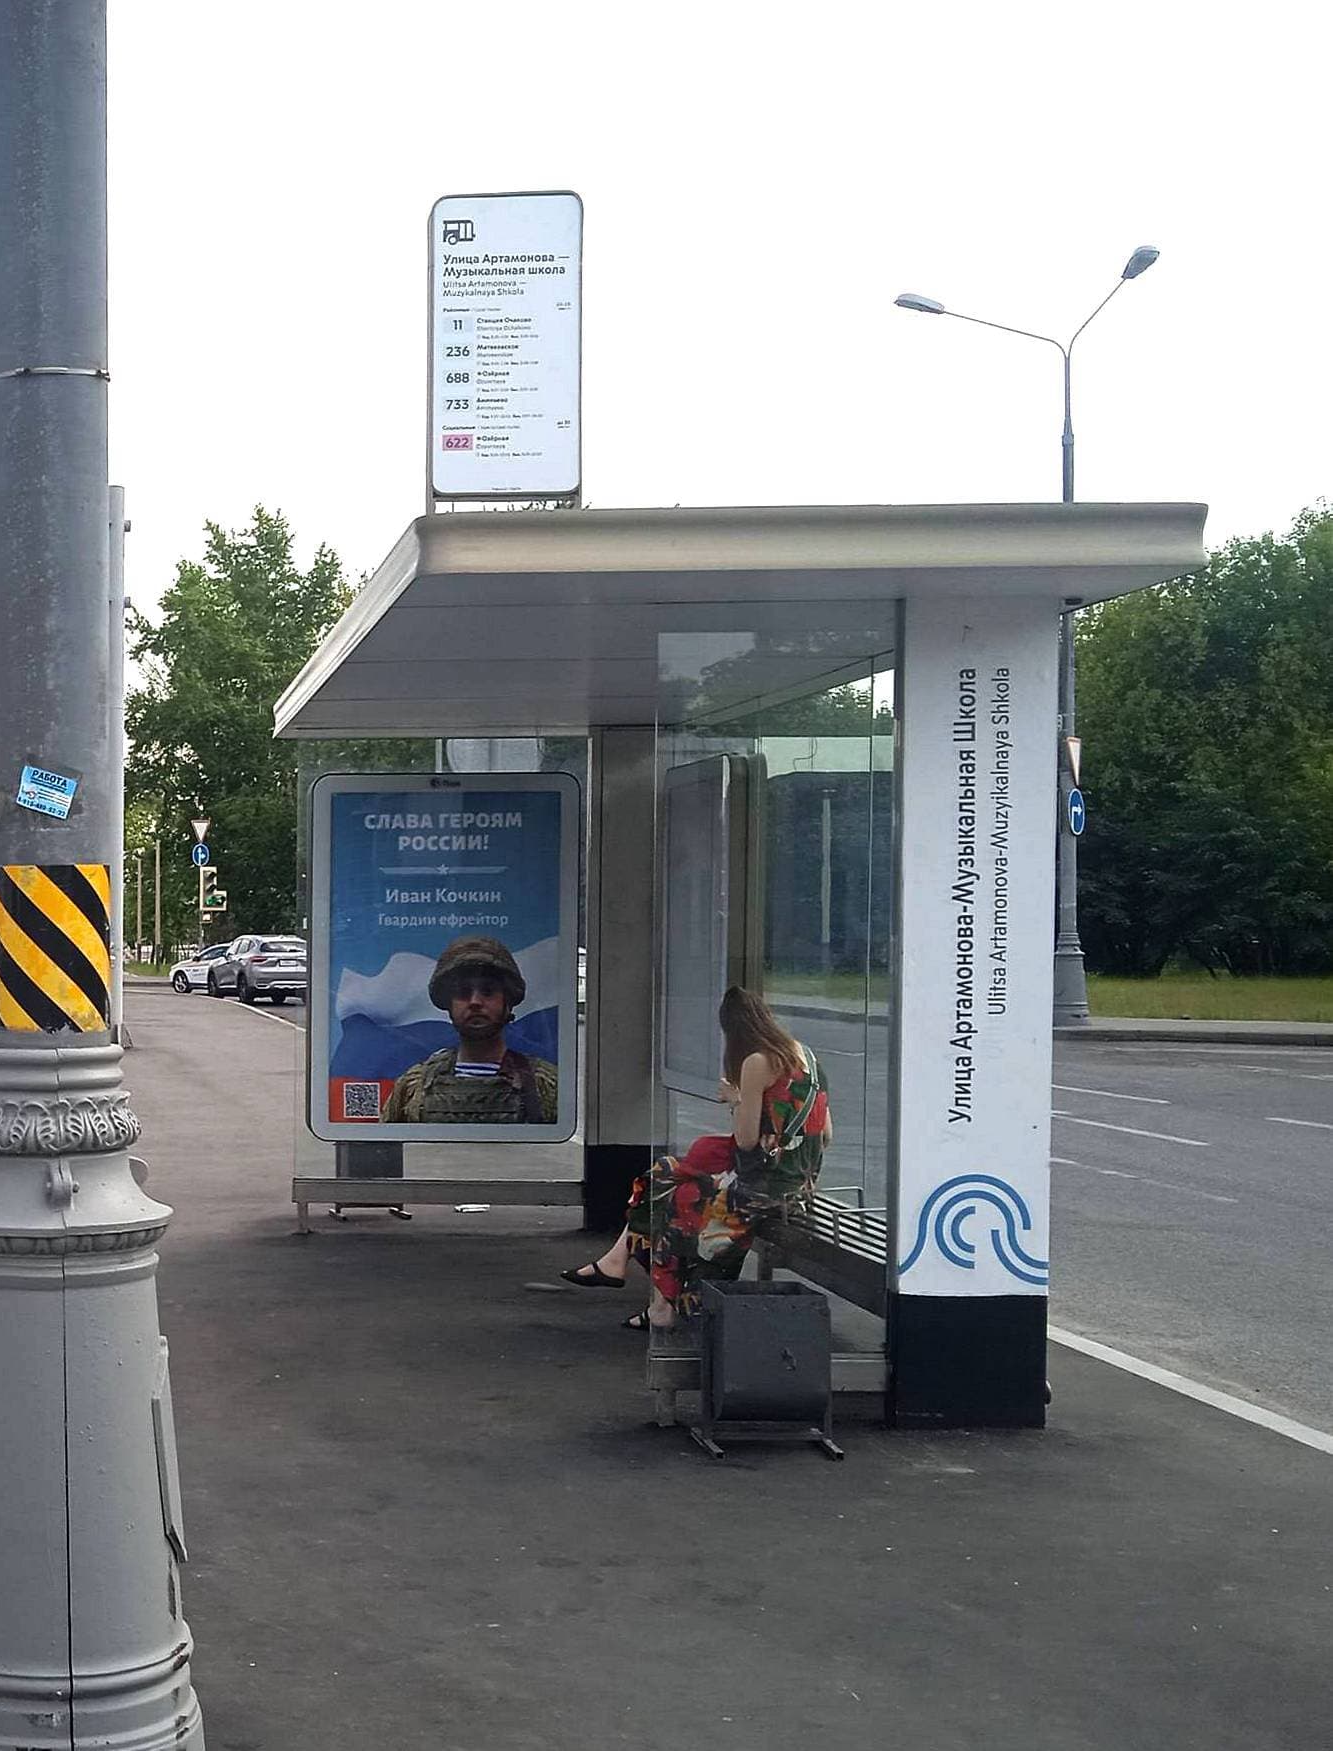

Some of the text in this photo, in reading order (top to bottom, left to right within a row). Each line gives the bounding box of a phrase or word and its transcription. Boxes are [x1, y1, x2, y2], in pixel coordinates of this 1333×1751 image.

[443, 254, 480, 265] Улица
[482, 253, 555, 266] Артамонова
[443, 266, 566, 278] Музыкальная школа
[453, 319, 463, 330] 11
[446, 346, 470, 357] 236
[446, 372, 470, 384] 688
[446, 399, 470, 410] 733
[446, 437, 469, 449] 622
[32, 770, 68, 787] РАБОТА
[364, 812, 523, 830] СЛАВА ГЕРОЯМ
[398, 834, 490, 851] РОССИИ!
[987, 668, 1013, 1016] Ulitsa Artamonova-Muzyikalnaya Shkola
[385, 888, 502, 903] Иван Кочкин
[948, 668, 980, 1123] Улица Артамонова-Музыкальная Школа
[378, 912, 509, 928] Гвардии ефрейтор
